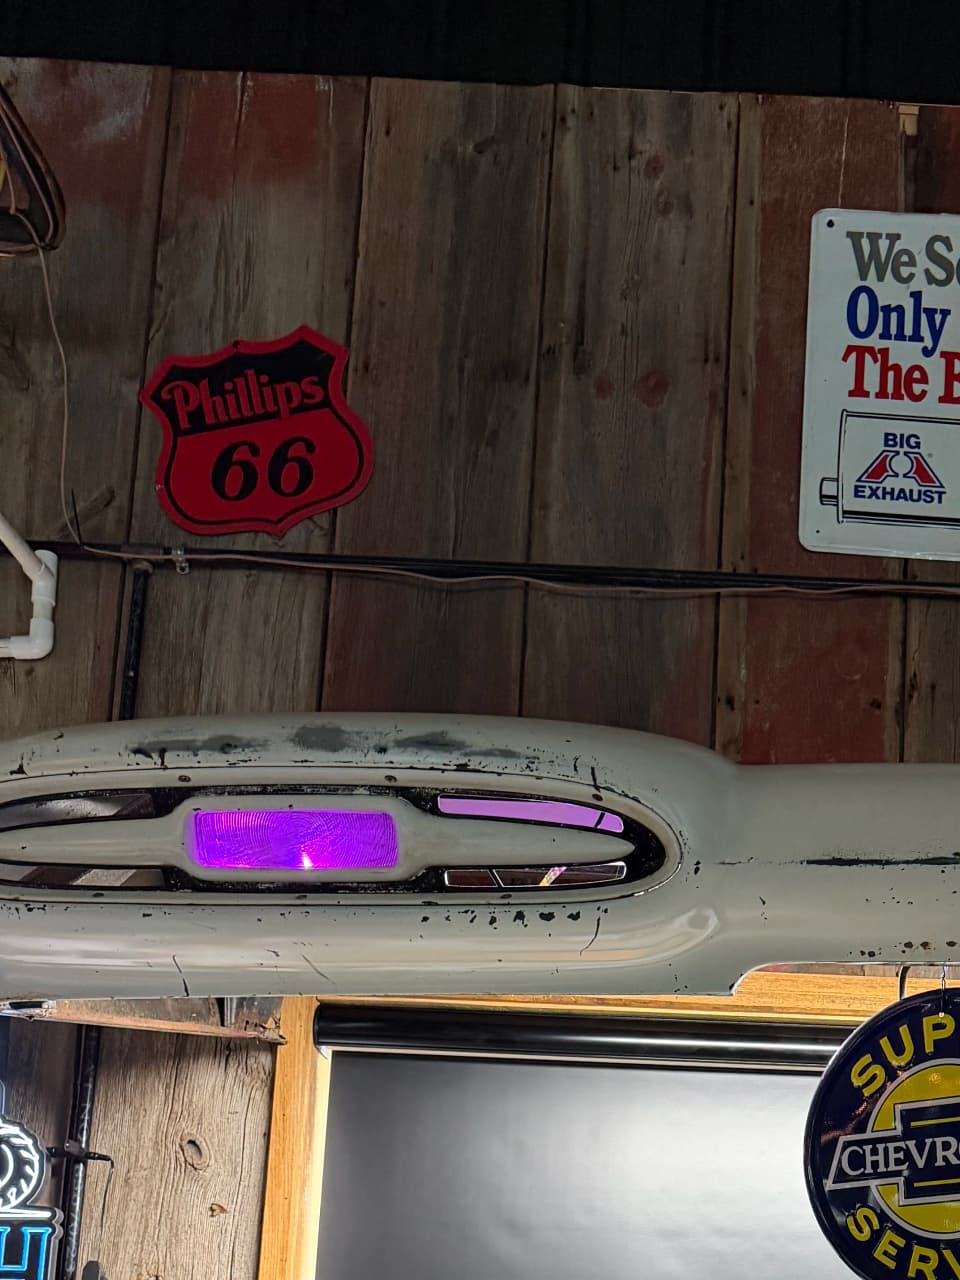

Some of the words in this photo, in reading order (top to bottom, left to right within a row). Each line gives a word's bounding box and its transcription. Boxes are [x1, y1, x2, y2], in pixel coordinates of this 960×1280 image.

[846, 231, 917, 285] We
[846, 285, 952, 358] Only
[160, 368, 326, 430] Phillips
[841, 344, 929, 403] The
[211, 436, 318, 502] 66
[883, 431, 922, 450] BIG
[853, 484, 947, 505] EXHAUST
